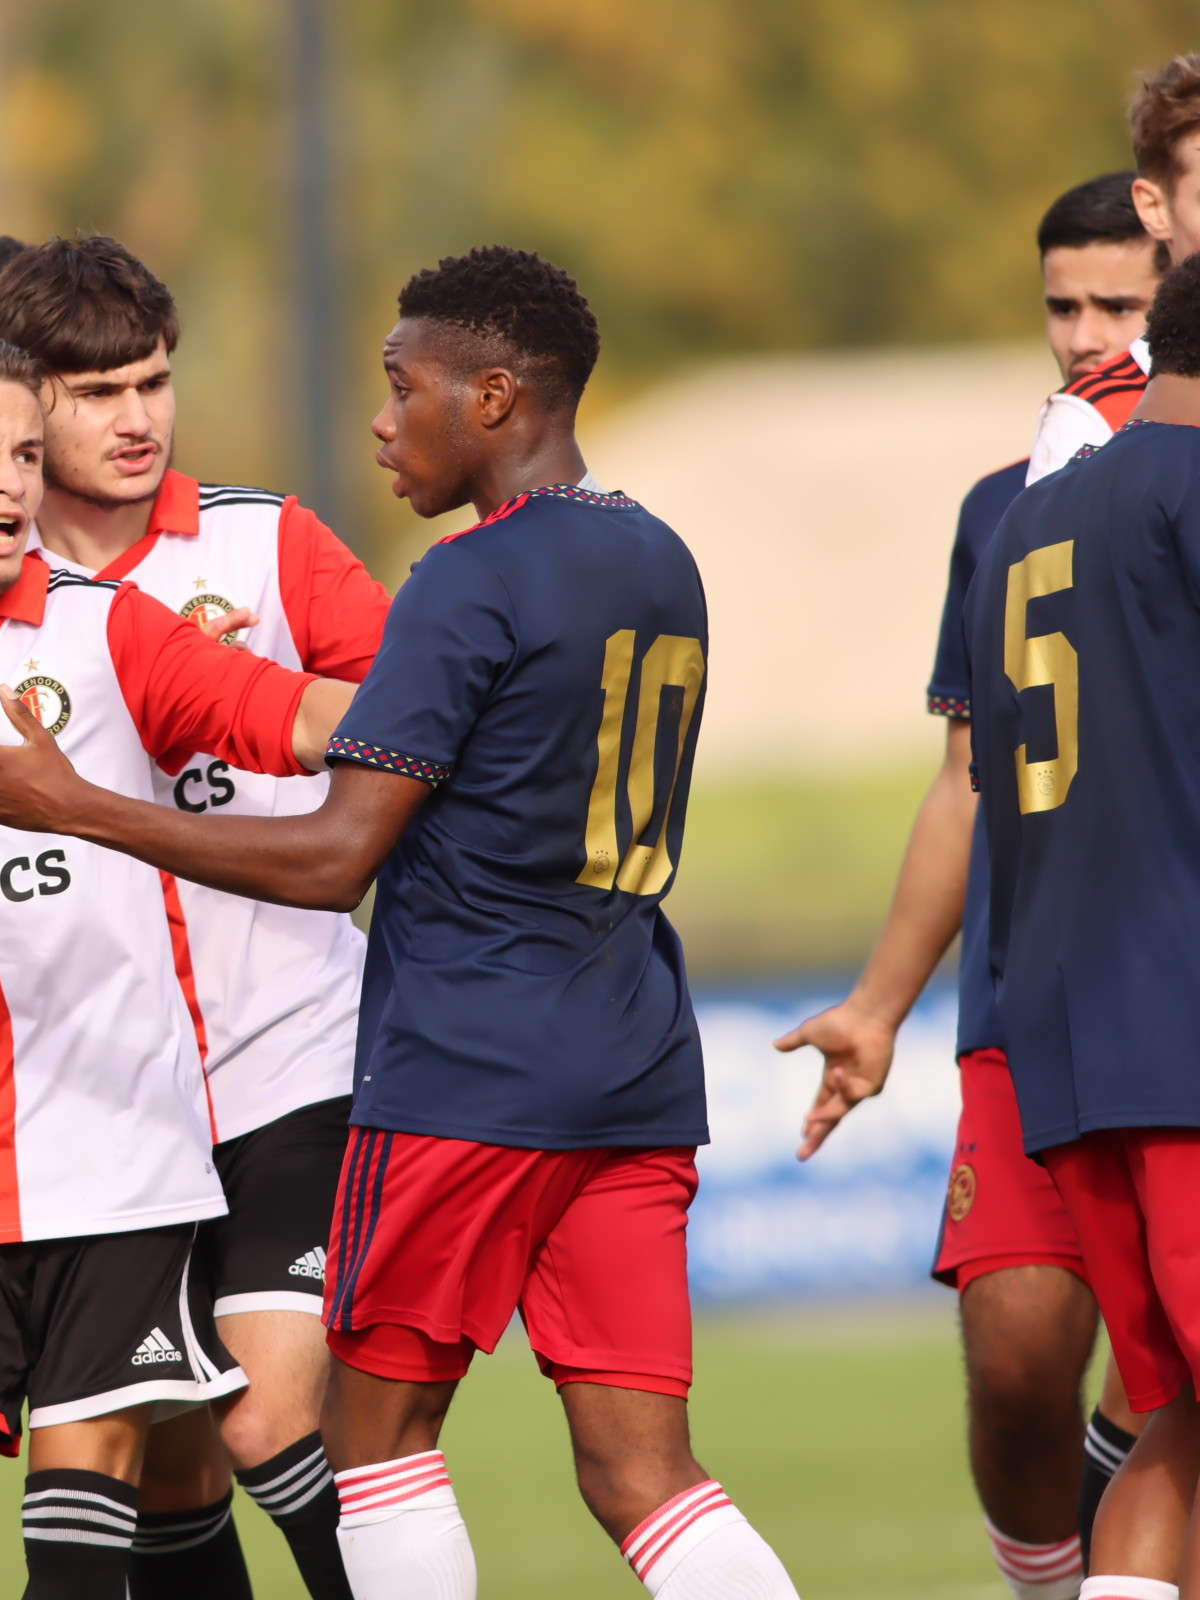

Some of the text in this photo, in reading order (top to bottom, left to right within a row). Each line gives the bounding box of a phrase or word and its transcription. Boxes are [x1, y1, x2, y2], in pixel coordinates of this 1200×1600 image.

[181, 595, 232, 616] EYENOORD
[14, 677, 64, 698] EYENOORD
[1004, 539, 1078, 815] 5
[575, 629, 705, 895] 10
[288, 1264, 326, 1284] adid
[131, 1349, 183, 1366] adidas
